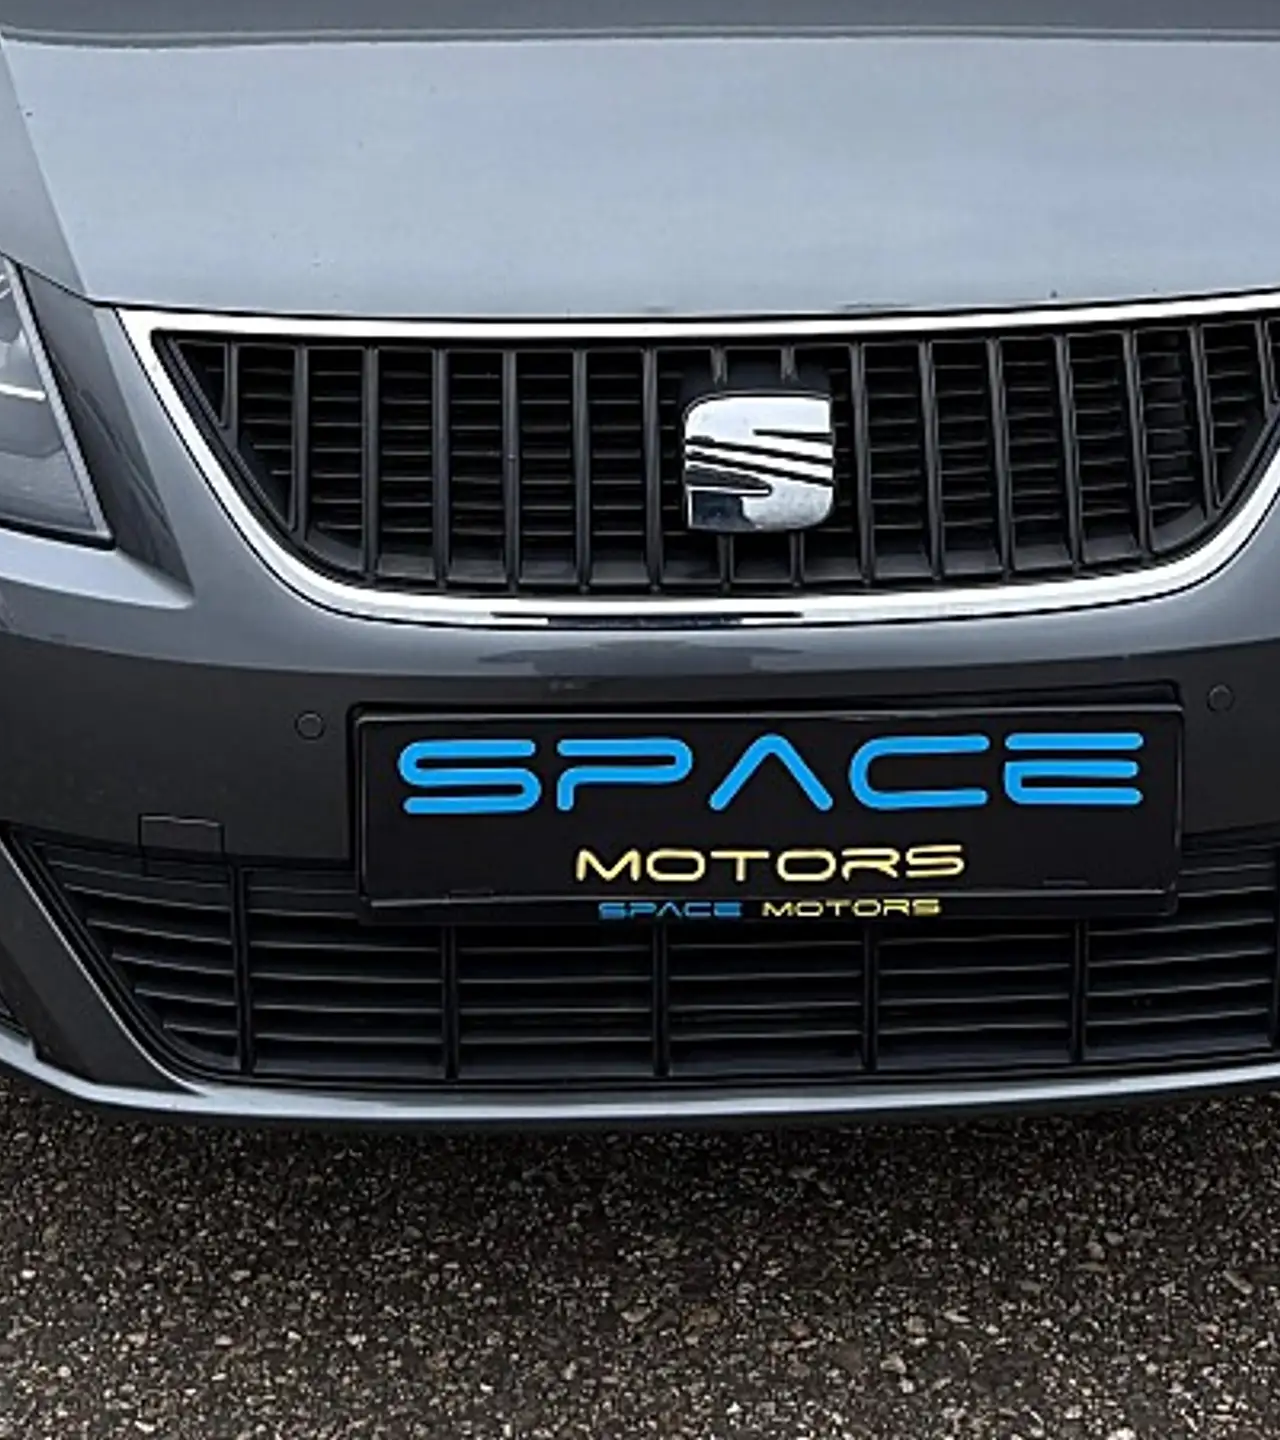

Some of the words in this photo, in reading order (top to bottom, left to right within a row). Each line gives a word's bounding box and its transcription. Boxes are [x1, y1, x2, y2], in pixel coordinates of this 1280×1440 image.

[397, 732, 1144, 815] SPACE
[575, 844, 965, 883] MOTORS
[598, 900, 742, 919] SPACE
[762, 898, 941, 917] MOTORS
